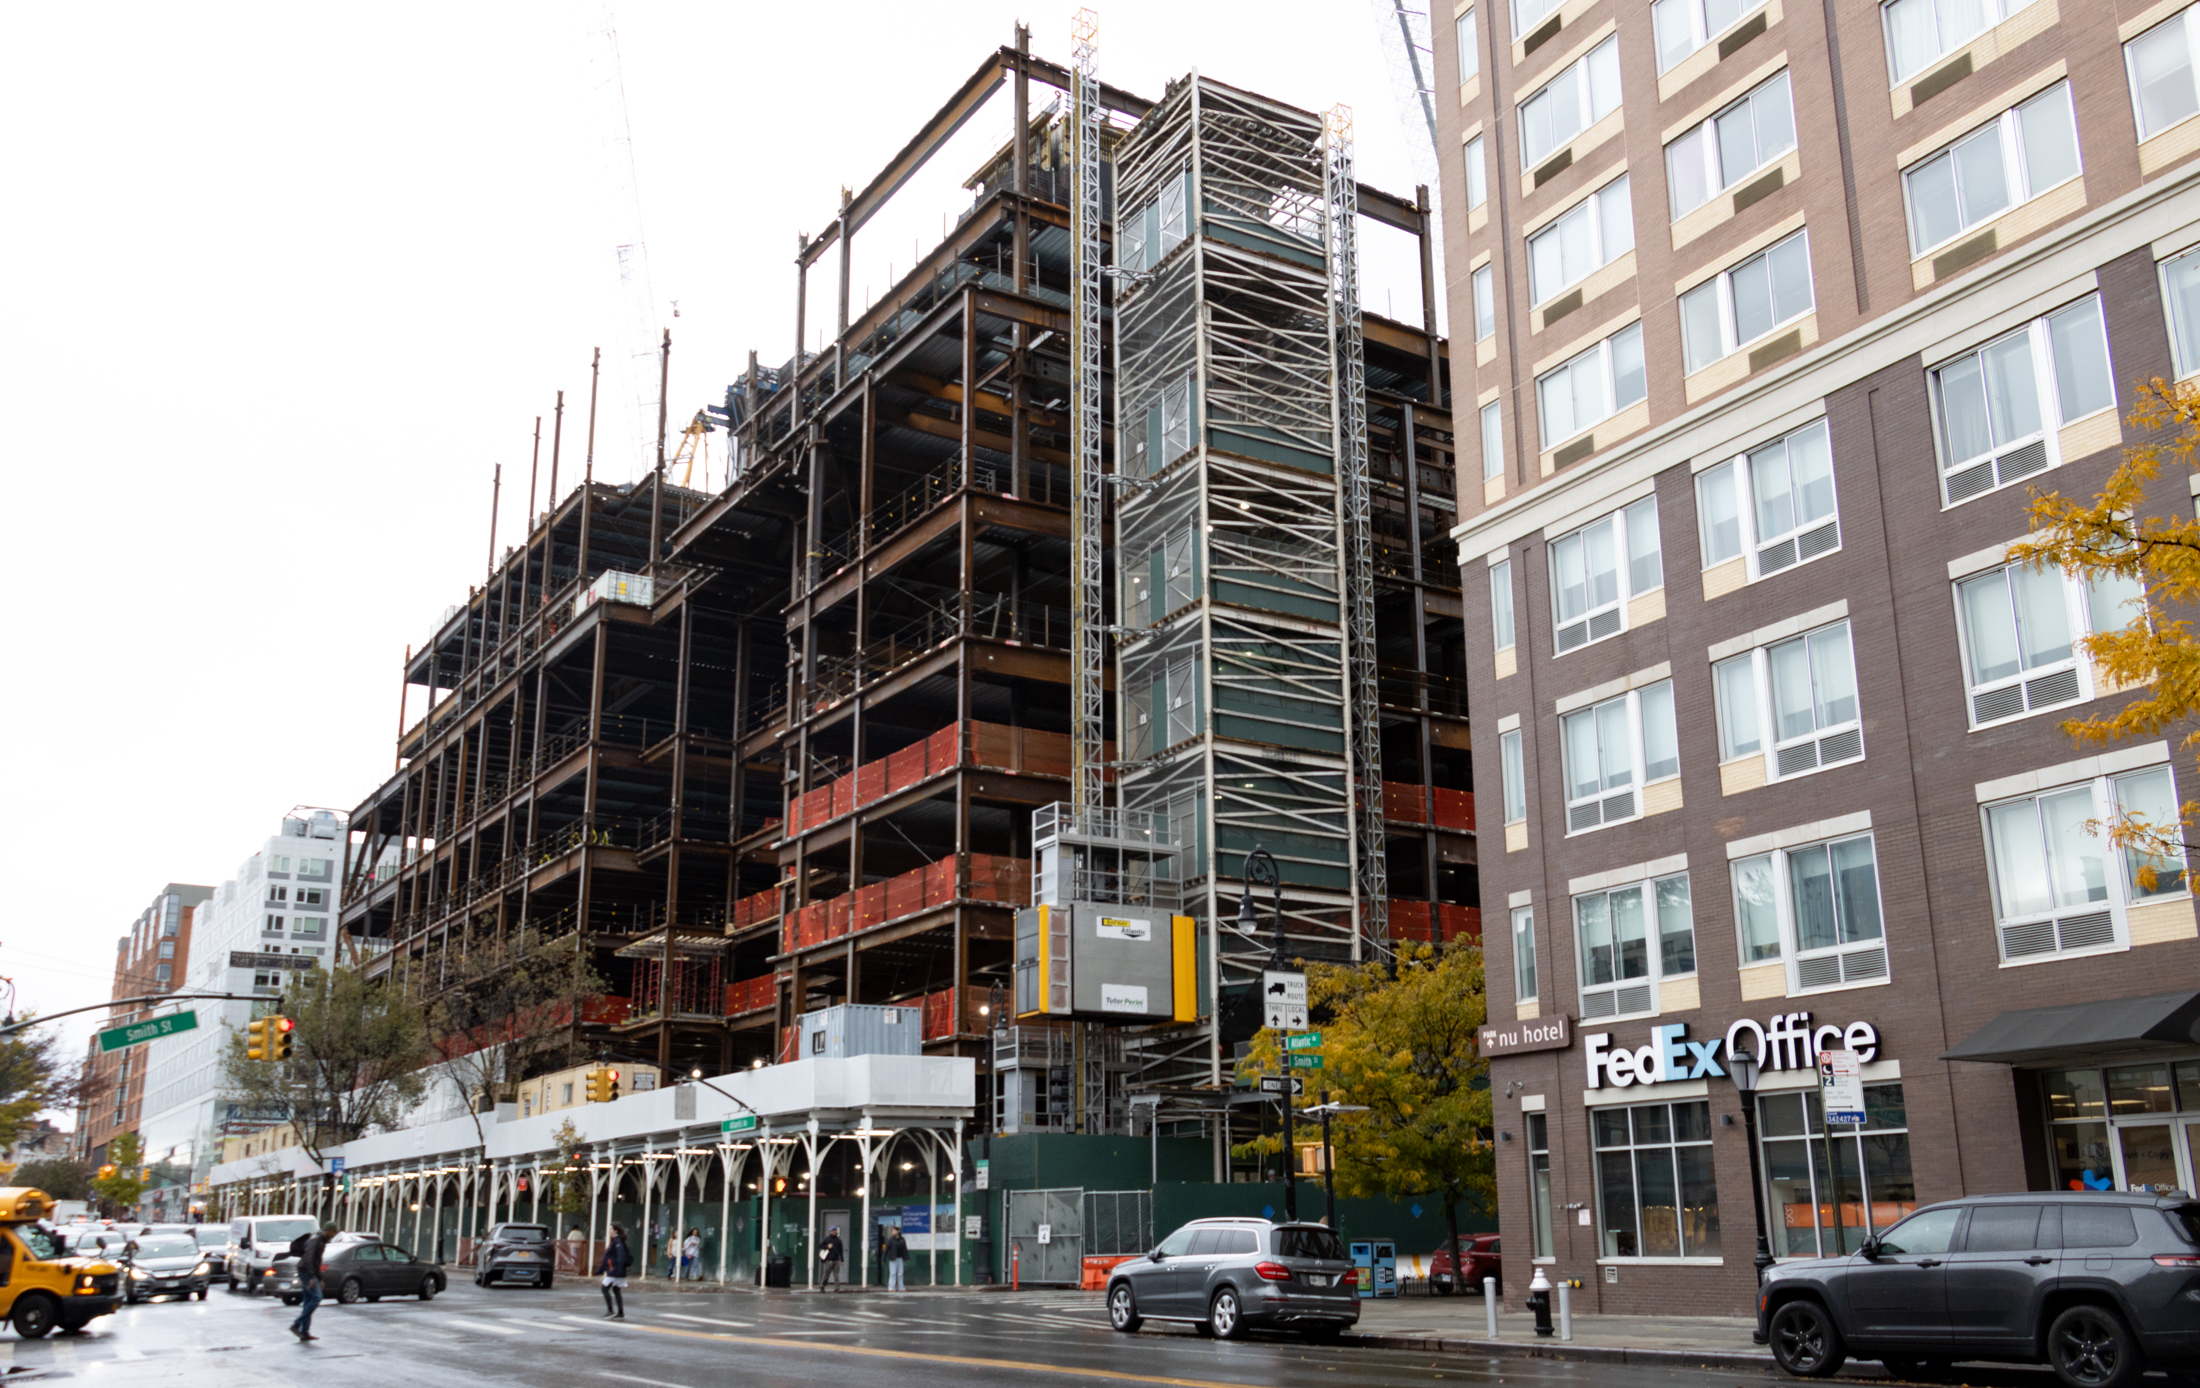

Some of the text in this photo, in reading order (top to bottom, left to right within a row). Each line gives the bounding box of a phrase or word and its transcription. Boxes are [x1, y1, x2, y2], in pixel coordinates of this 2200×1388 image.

[1121, 927, 1146, 935] Atlantic
[1287, 981, 1304, 989] TRUCK
[126, 1020, 173, 1042] Smith St
[1483, 1030, 1497, 1039] PARK
[1499, 1020, 1563, 1047] nu hotel
[1291, 1036, 1311, 1048] Atlantic
[1584, 1012, 1879, 1088] FedEx Office
[1294, 1056, 1312, 1067] Smith
[1825, 1076, 1833, 1086] 2
[1828, 1115, 1851, 1123] 342427
[2147, 1151, 2170, 1160] Copy
[2130, 1183, 2176, 1192] FedEx Office
